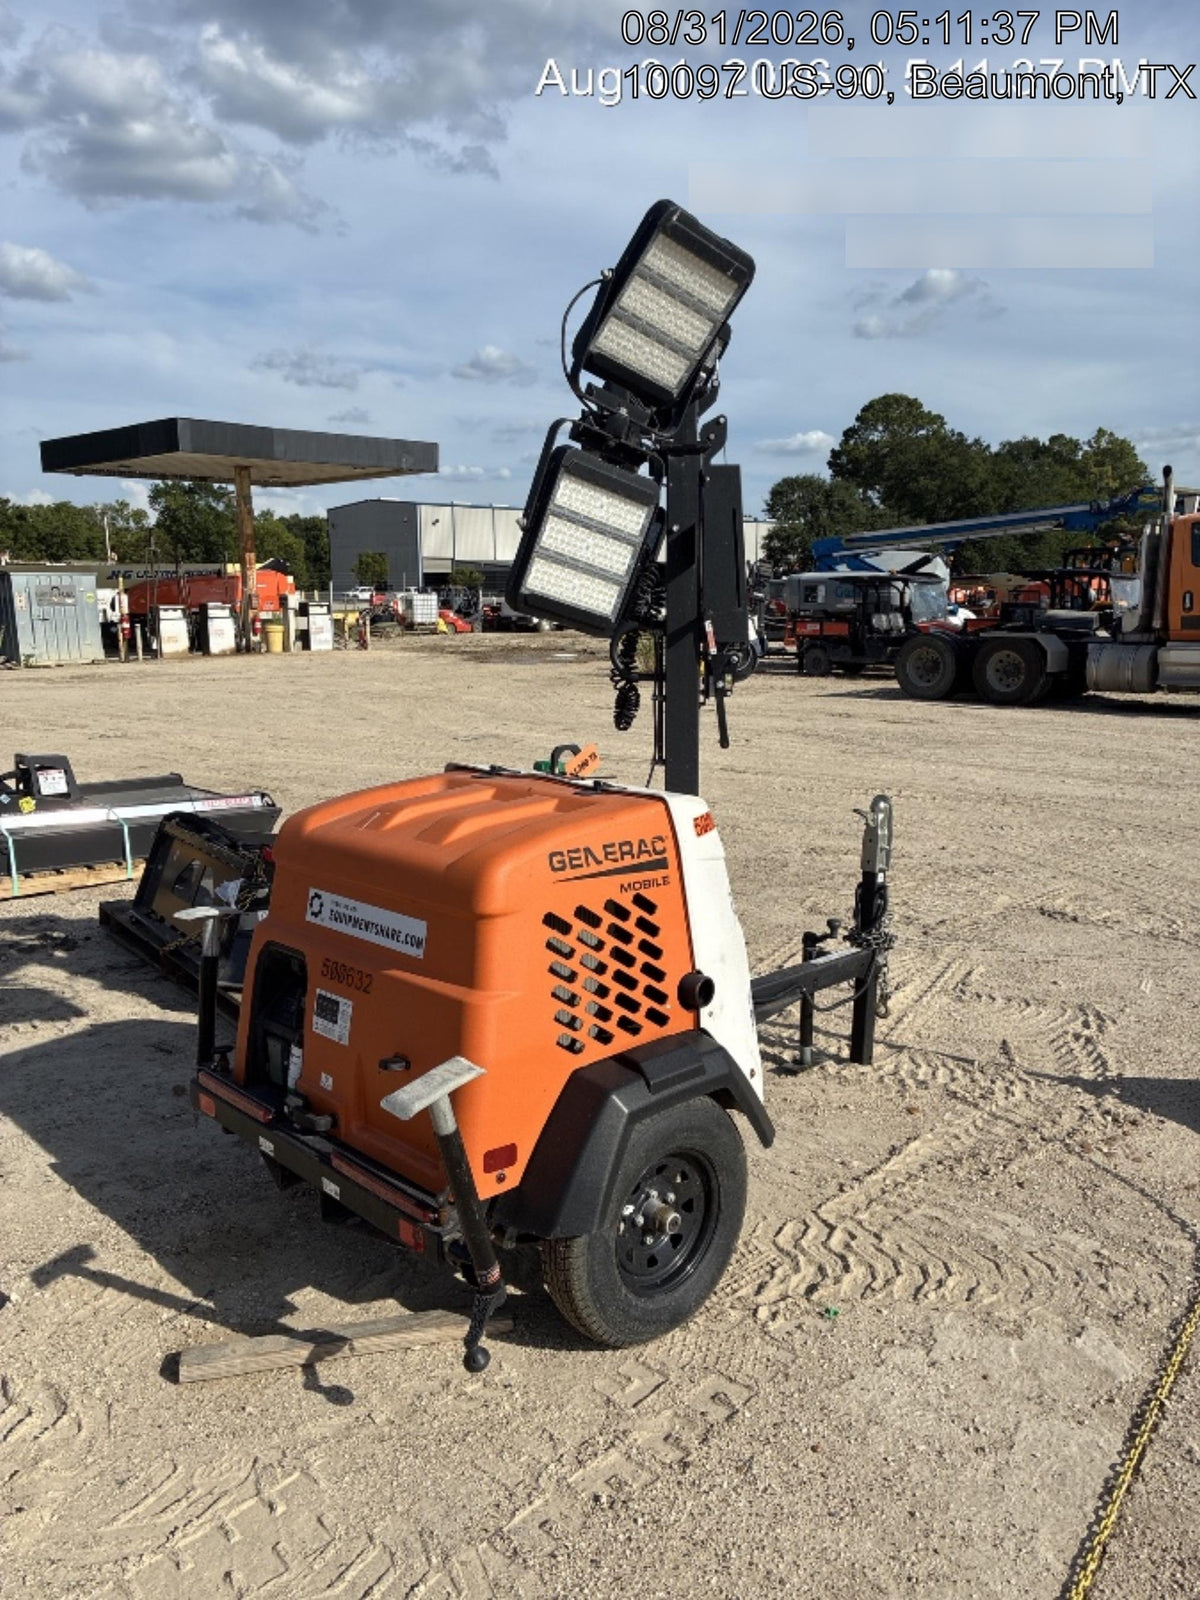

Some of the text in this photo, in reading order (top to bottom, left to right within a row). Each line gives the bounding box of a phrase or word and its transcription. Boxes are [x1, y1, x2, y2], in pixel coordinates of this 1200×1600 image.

[548, 835, 667, 873] GENERAC
[620, 876, 670, 894] MOBILE
[328, 908, 424, 950] EQUIPMENTSHARE.COM
